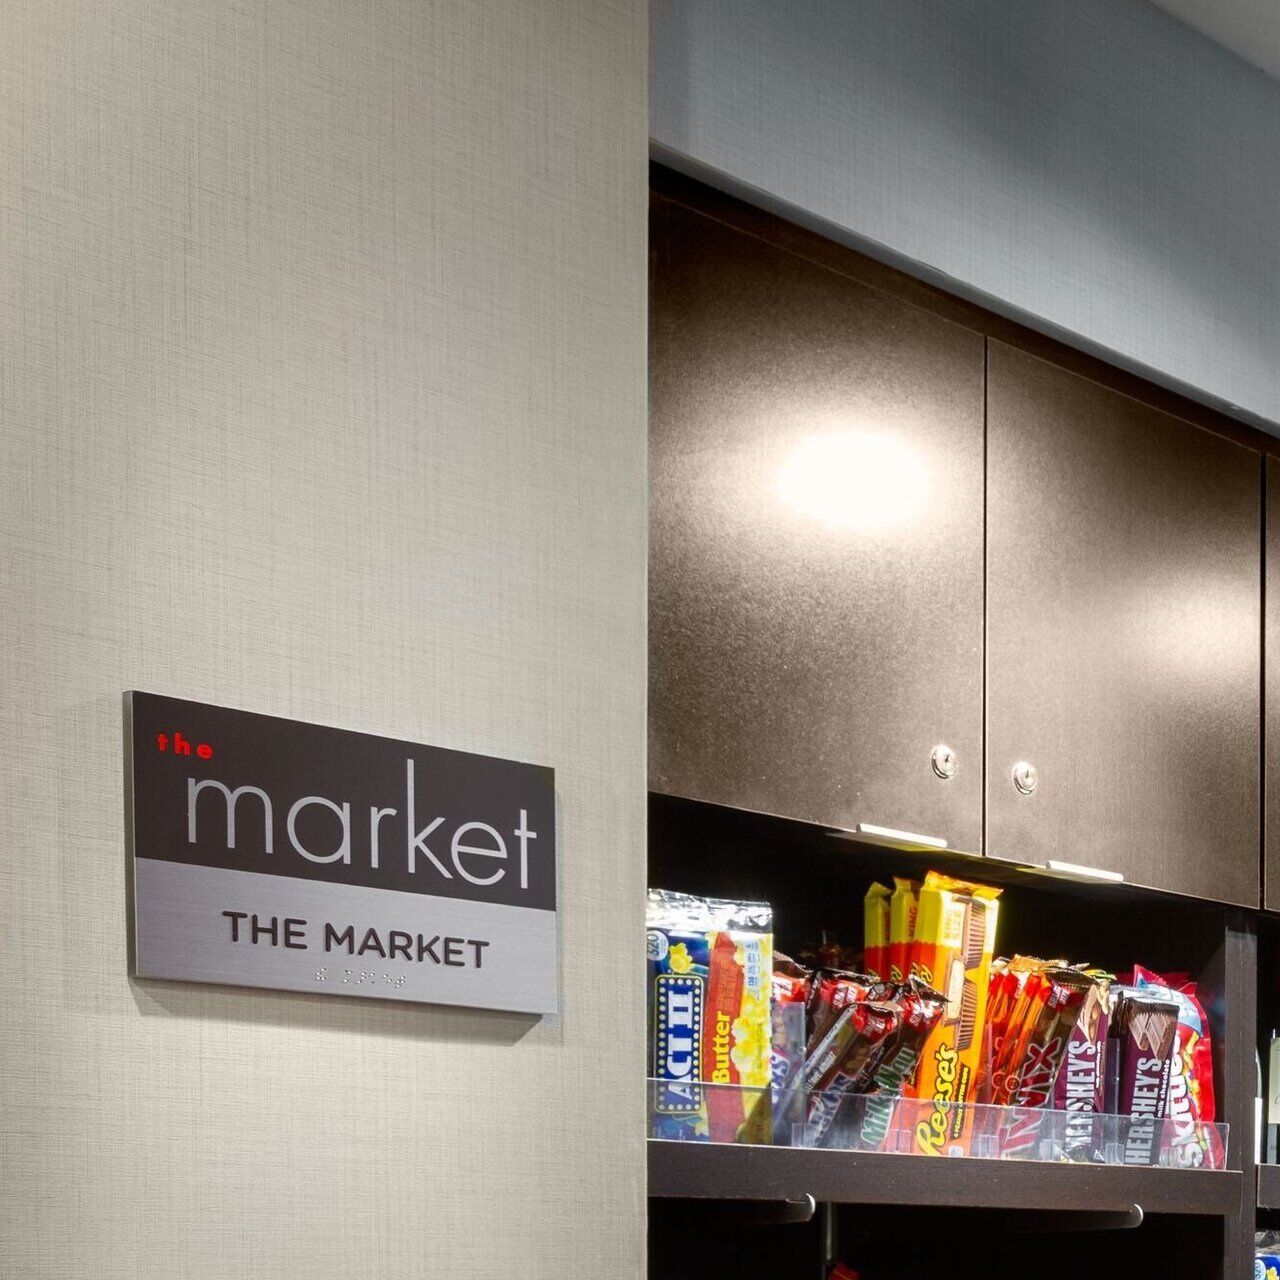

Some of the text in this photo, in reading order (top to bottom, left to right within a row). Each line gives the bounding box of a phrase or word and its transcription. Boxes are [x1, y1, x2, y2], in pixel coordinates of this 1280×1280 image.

[156, 731, 213, 760] the
[187, 758, 538, 889] market
[222, 909, 491, 969] THE MARKET
[908, 905, 918, 937] KING
[666, 990, 693, 1100] ACT II
[711, 1010, 731, 1084] Butter
[1160, 1059, 1171, 1099] chocolate
[916, 1042, 959, 1157] Reese's
[1066, 1040, 1097, 1148] HERSHEY'S
[1125, 1056, 1163, 1164] HERSHEY'S
